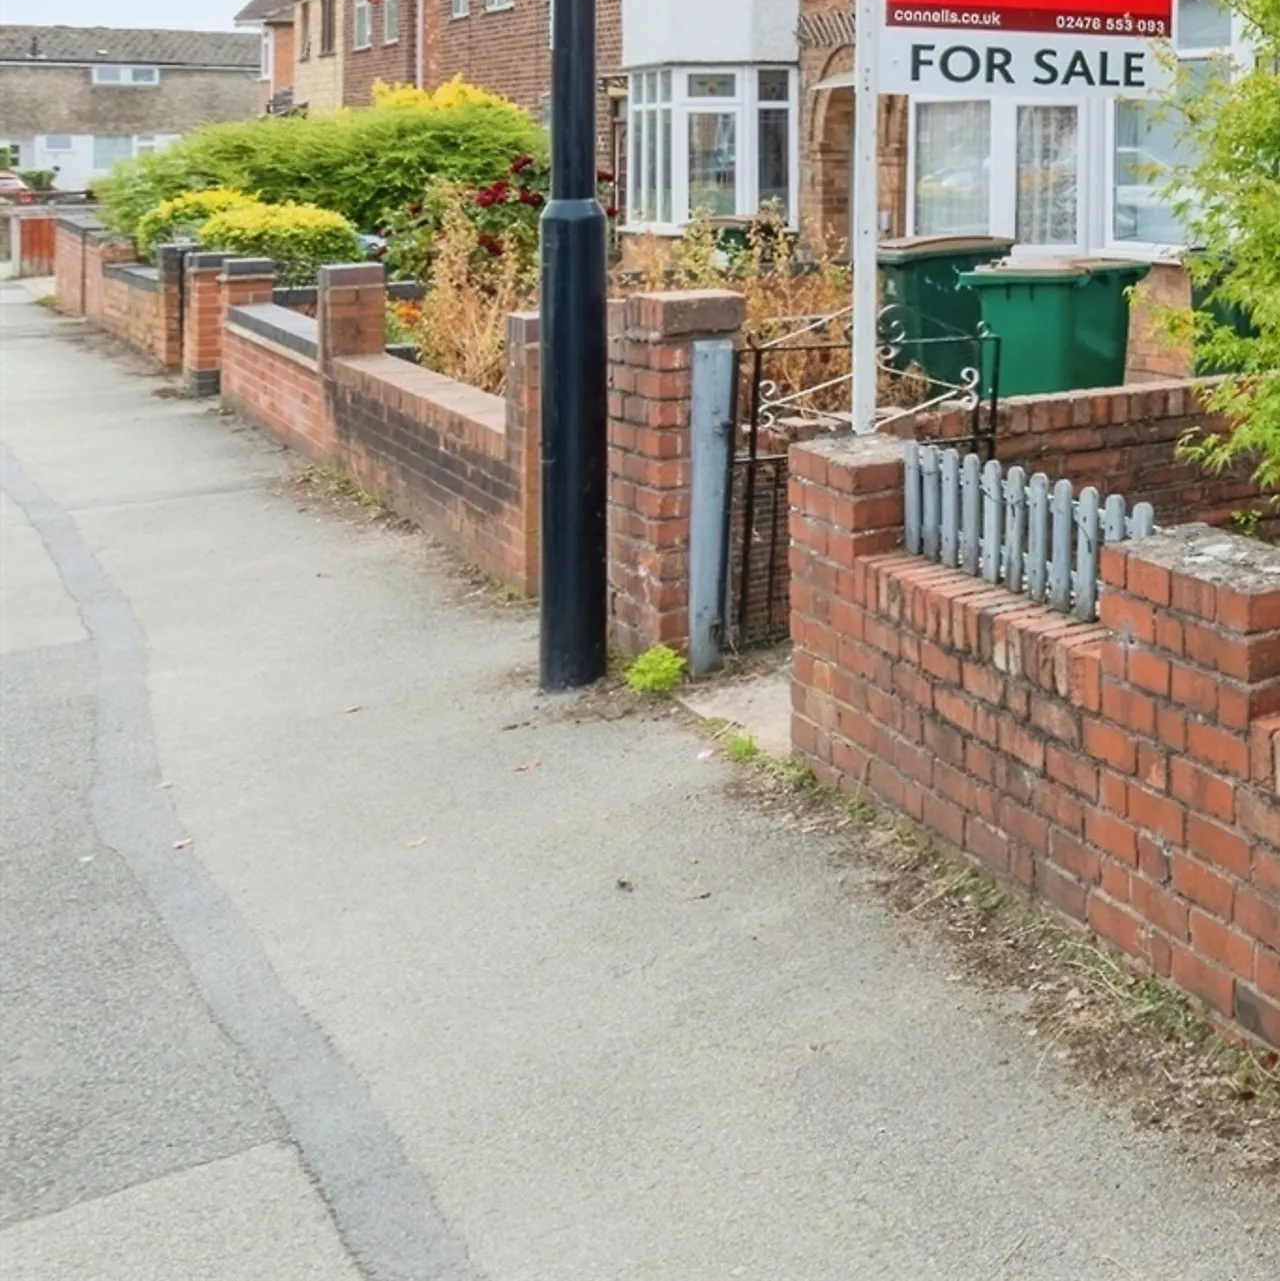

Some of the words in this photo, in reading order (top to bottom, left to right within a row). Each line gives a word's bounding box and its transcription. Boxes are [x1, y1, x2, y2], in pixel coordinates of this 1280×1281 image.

[894, 9, 1001, 25] connells.co.uk
[911, 44, 1015, 84] FOR
[1033, 47, 1145, 87] SALE
